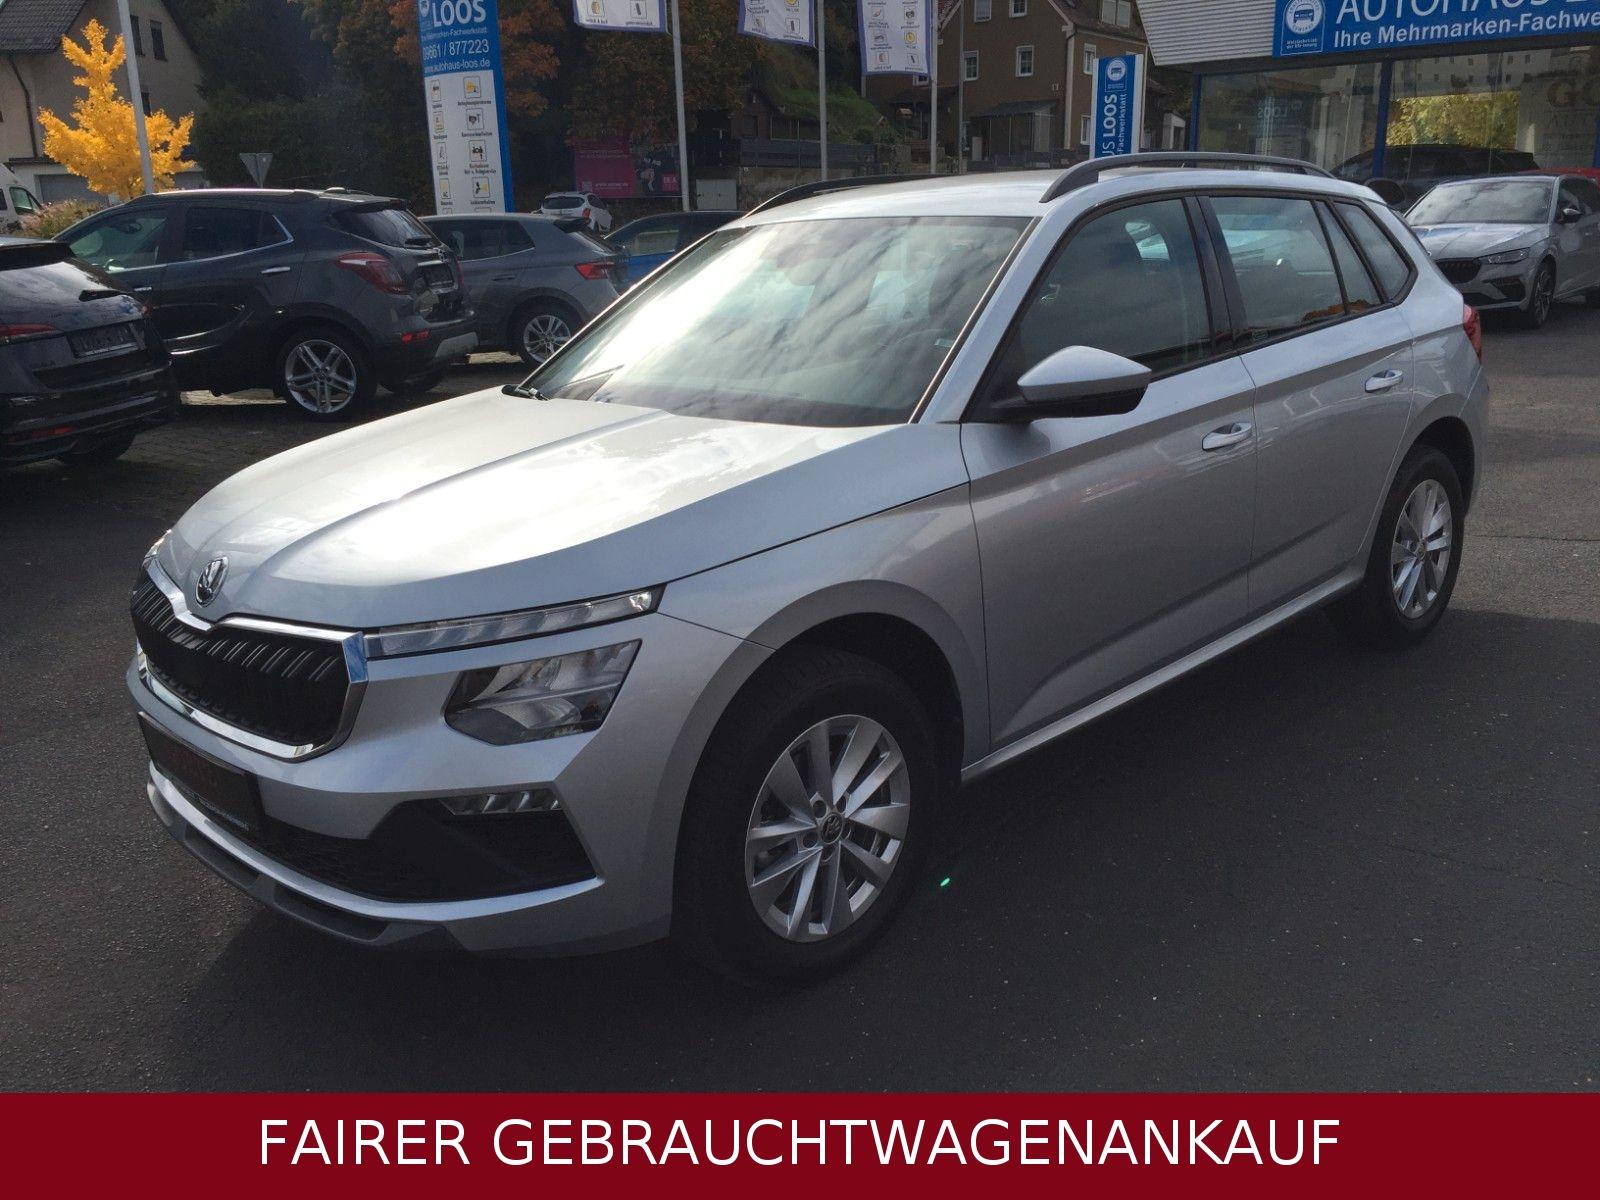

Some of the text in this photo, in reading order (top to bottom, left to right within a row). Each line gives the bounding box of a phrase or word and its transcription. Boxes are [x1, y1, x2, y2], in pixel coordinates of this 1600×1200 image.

[432, 0, 487, 27] LOOS
[449, 39, 490, 56] 877223
[1334, 29, 1371, 48] Ihre
[1103, 93, 1118, 138] LOOS
